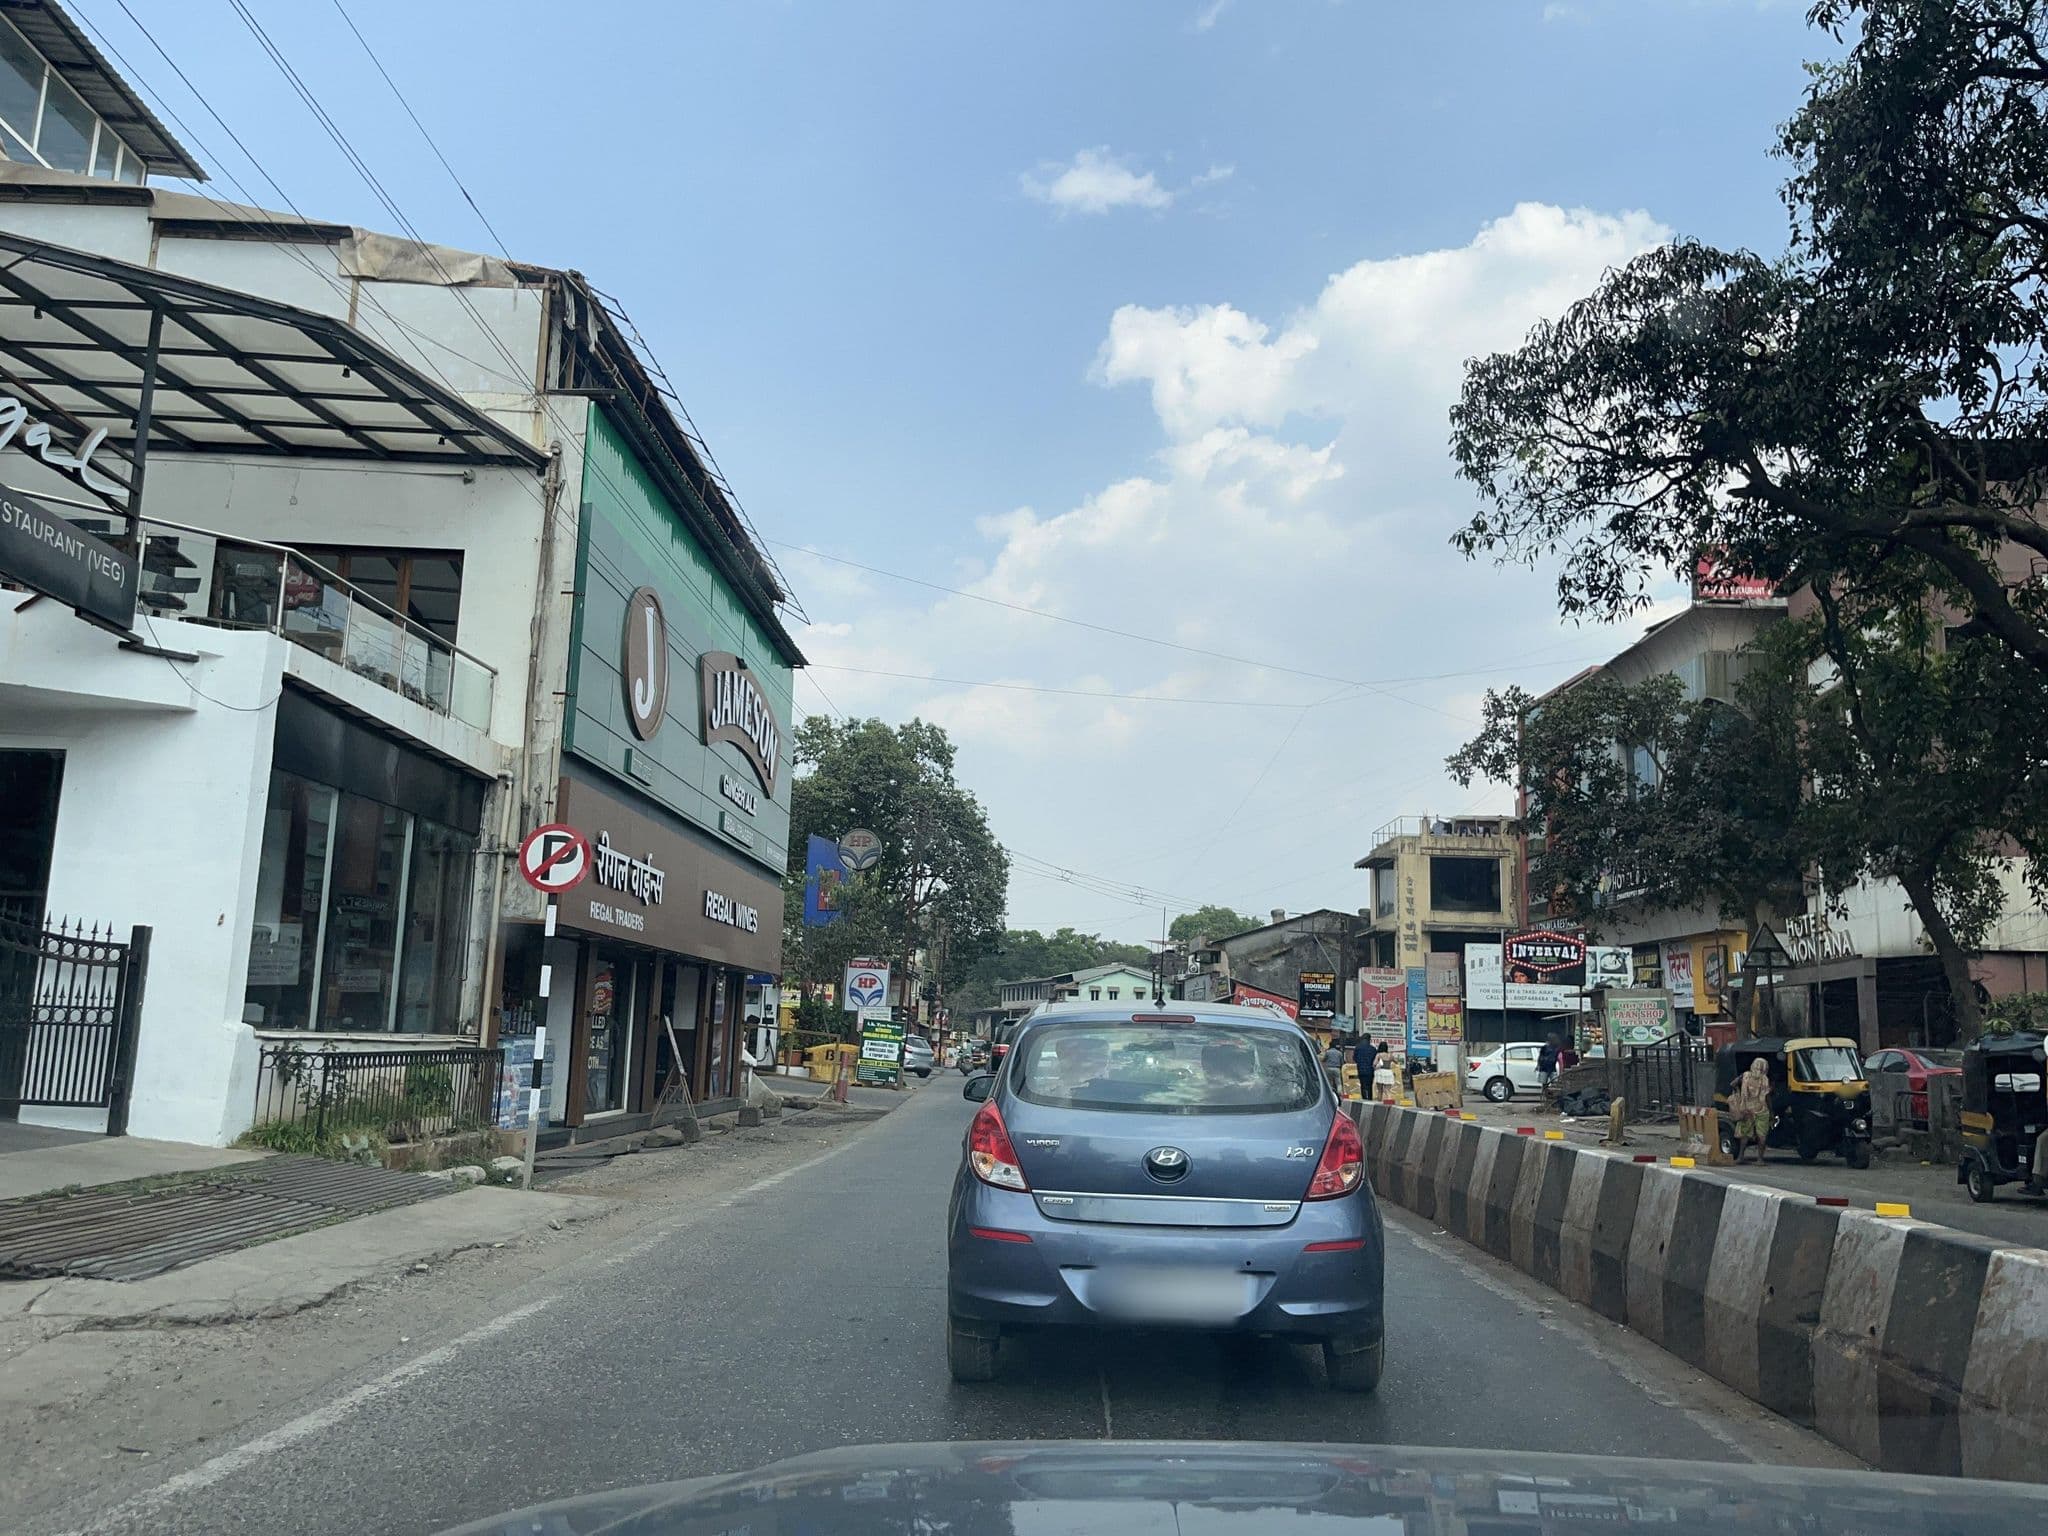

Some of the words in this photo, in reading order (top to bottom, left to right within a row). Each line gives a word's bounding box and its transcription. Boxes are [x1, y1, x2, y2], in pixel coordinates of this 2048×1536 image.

[0, 499, 85, 561] STAURANT
[88, 548, 125, 588] (VEG)
[634, 607, 656, 720] J
[711, 670, 777, 780] JAMESON
[598, 830, 631, 893] रीगल
[590, 900, 615, 923] REGAL
[615, 908, 644, 932] TRADERS
[705, 889, 734, 927] REGAL
[735, 902, 758, 934] WINES
[1512, 943, 1578, 960] INTERVAL
[858, 977, 877, 988] HP
[1614, 1010, 1638, 1019] PAAN
[1640, 1009, 1664, 1019] SHOP
